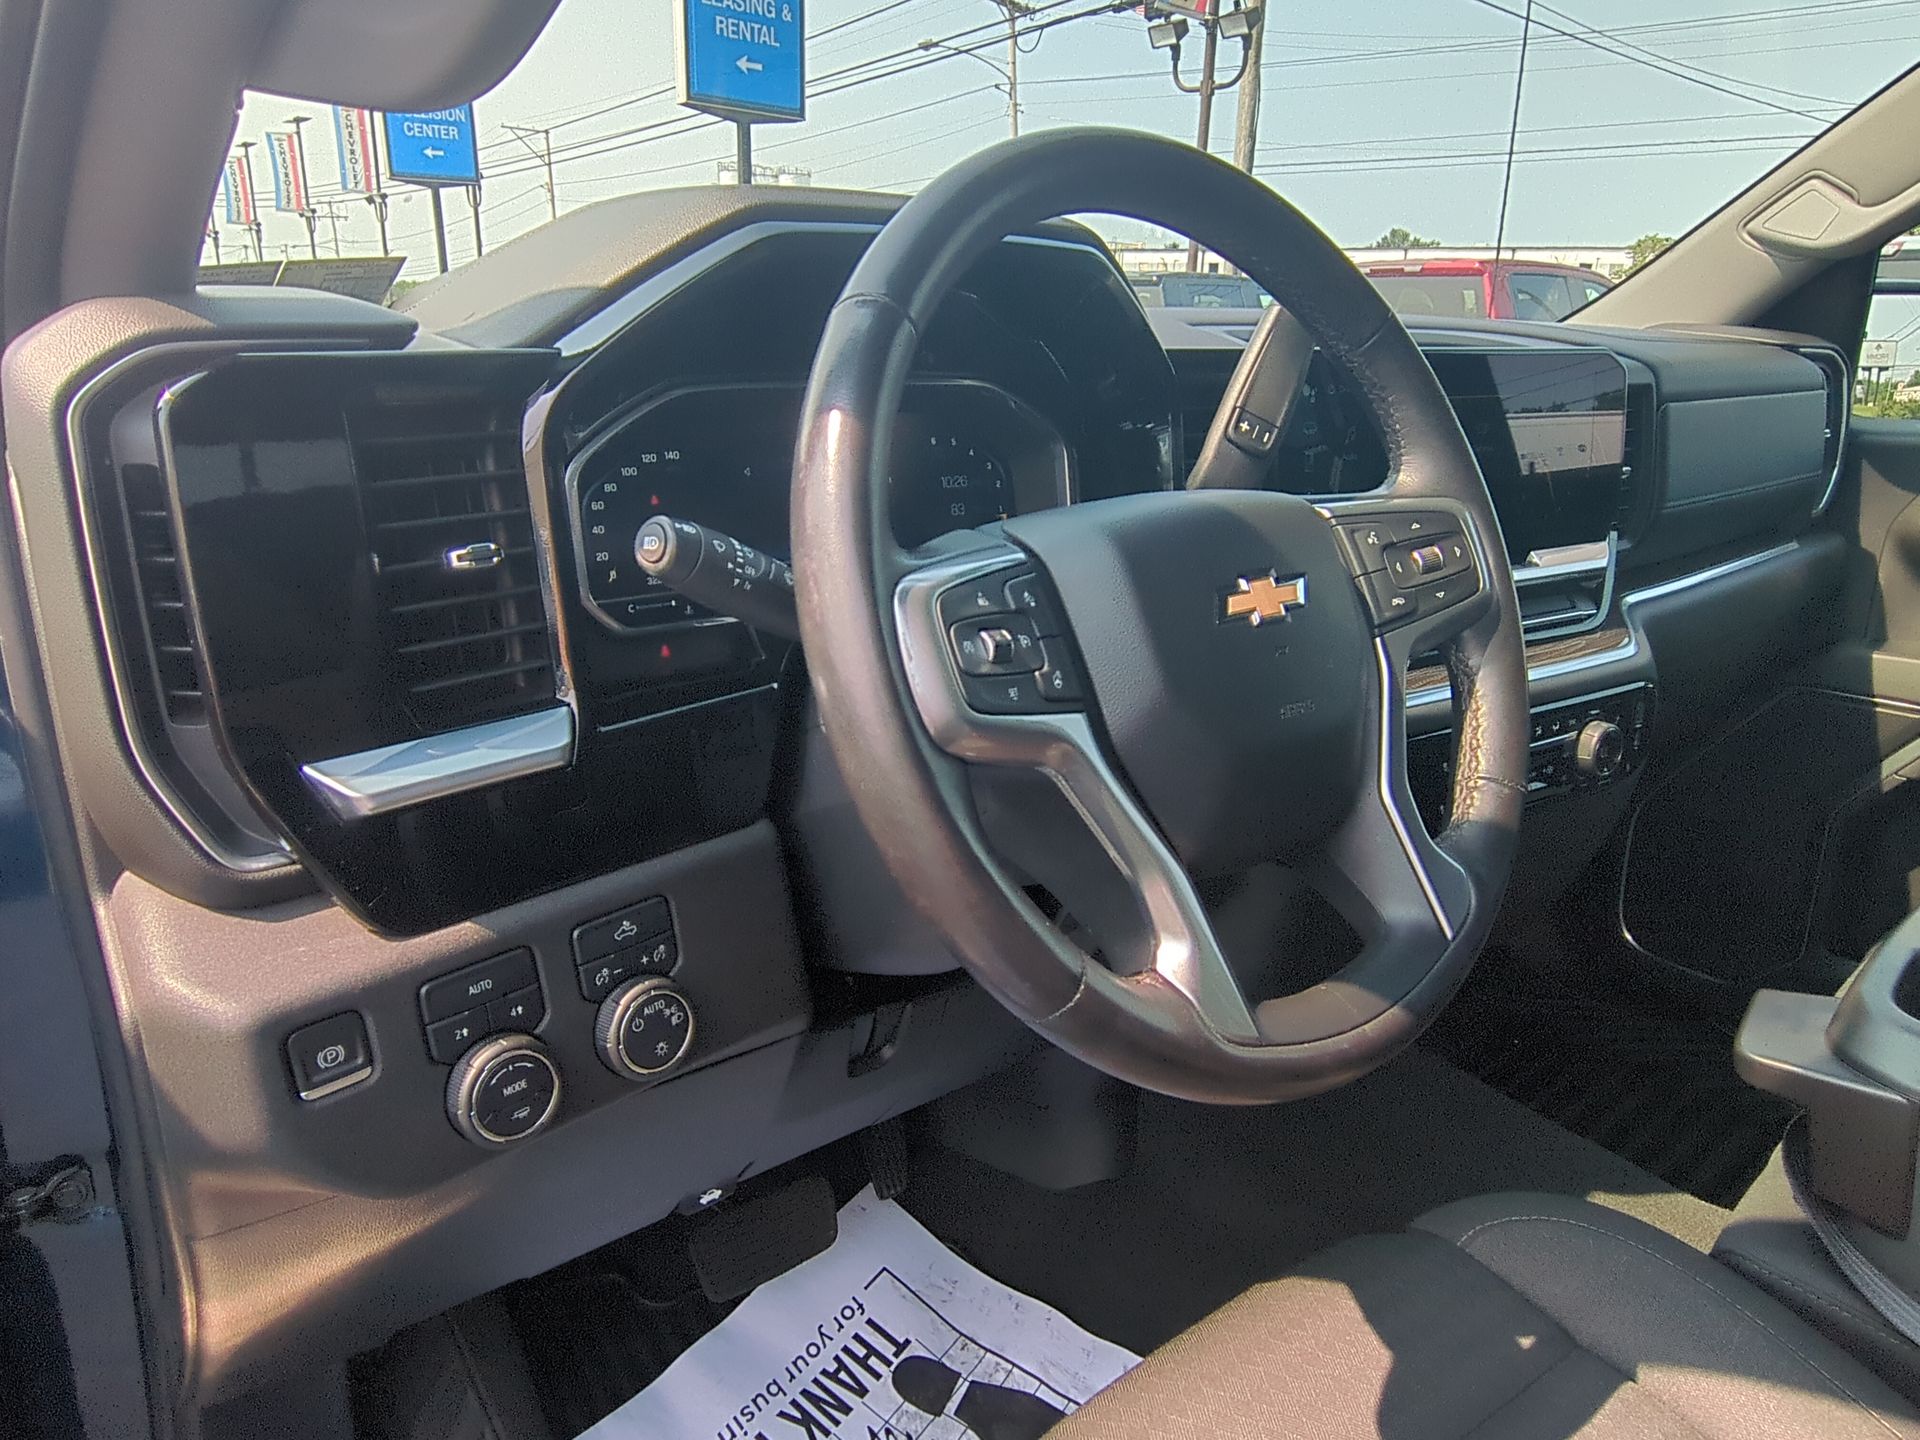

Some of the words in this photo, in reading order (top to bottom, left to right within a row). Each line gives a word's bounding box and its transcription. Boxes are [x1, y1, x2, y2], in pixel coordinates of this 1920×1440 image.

[702, 0, 776, 18] SING
[781, 3, 793, 22] &
[715, 15, 780, 47] RENTAL
[403, 122, 459, 140] CENTER
[344, 113, 359, 189] CHEVROLET
[641, 454, 657, 463] 120
[664, 451, 680, 460] 140
[621, 467, 637, 476] 100
[604, 483, 617, 492] 80
[591, 501, 604, 510] 60
[592, 525, 605, 534] 40
[596, 552, 609, 561] 20
[468, 979, 492, 996] AUTO
[643, 999, 666, 1017] AUTO
[502, 1078, 528, 1097] MODE
[832, 1295, 866, 1333] for
[784, 1323, 835, 1383] your
[775, 1316, 913, 1440] THANK
